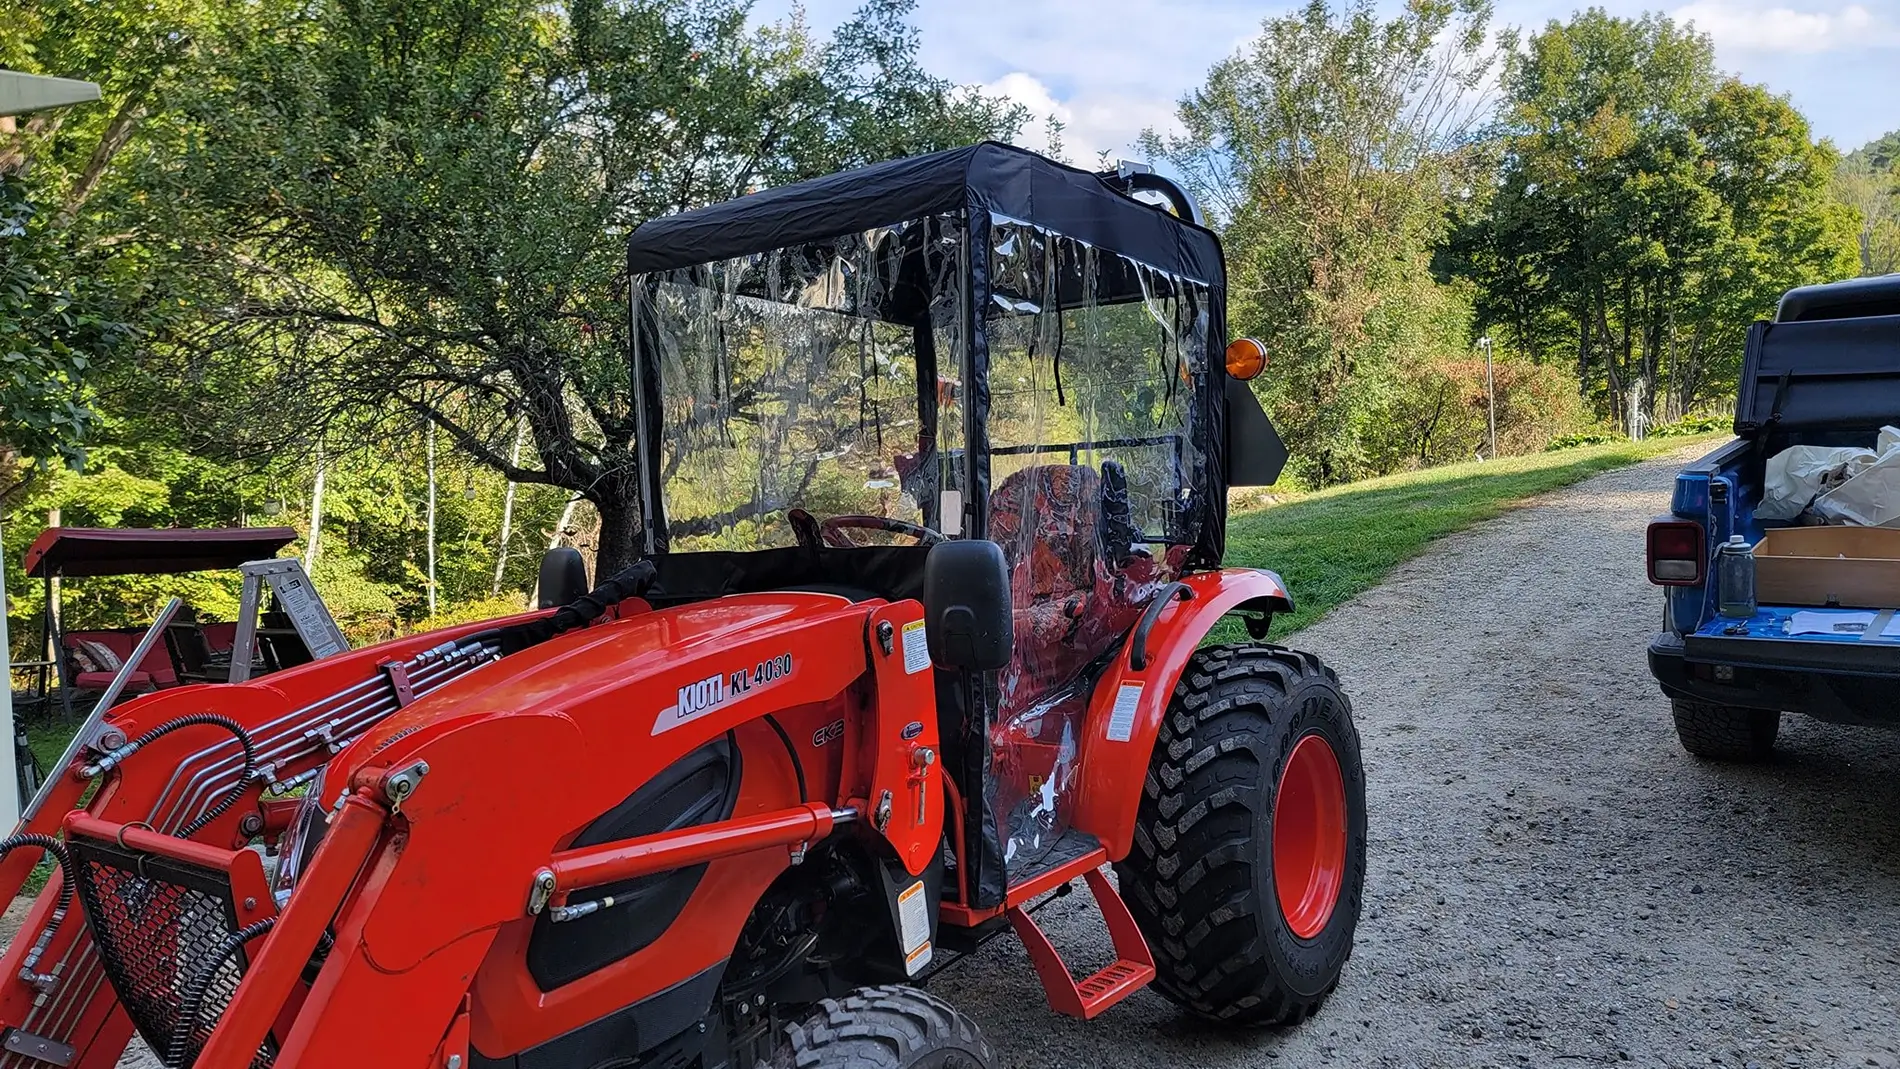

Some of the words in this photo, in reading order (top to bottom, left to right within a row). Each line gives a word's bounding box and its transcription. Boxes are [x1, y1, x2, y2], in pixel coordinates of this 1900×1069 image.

[678, 673, 723, 718] KIOTI
[730, 668, 751, 698] KL
[754, 653, 792, 687] 4030
